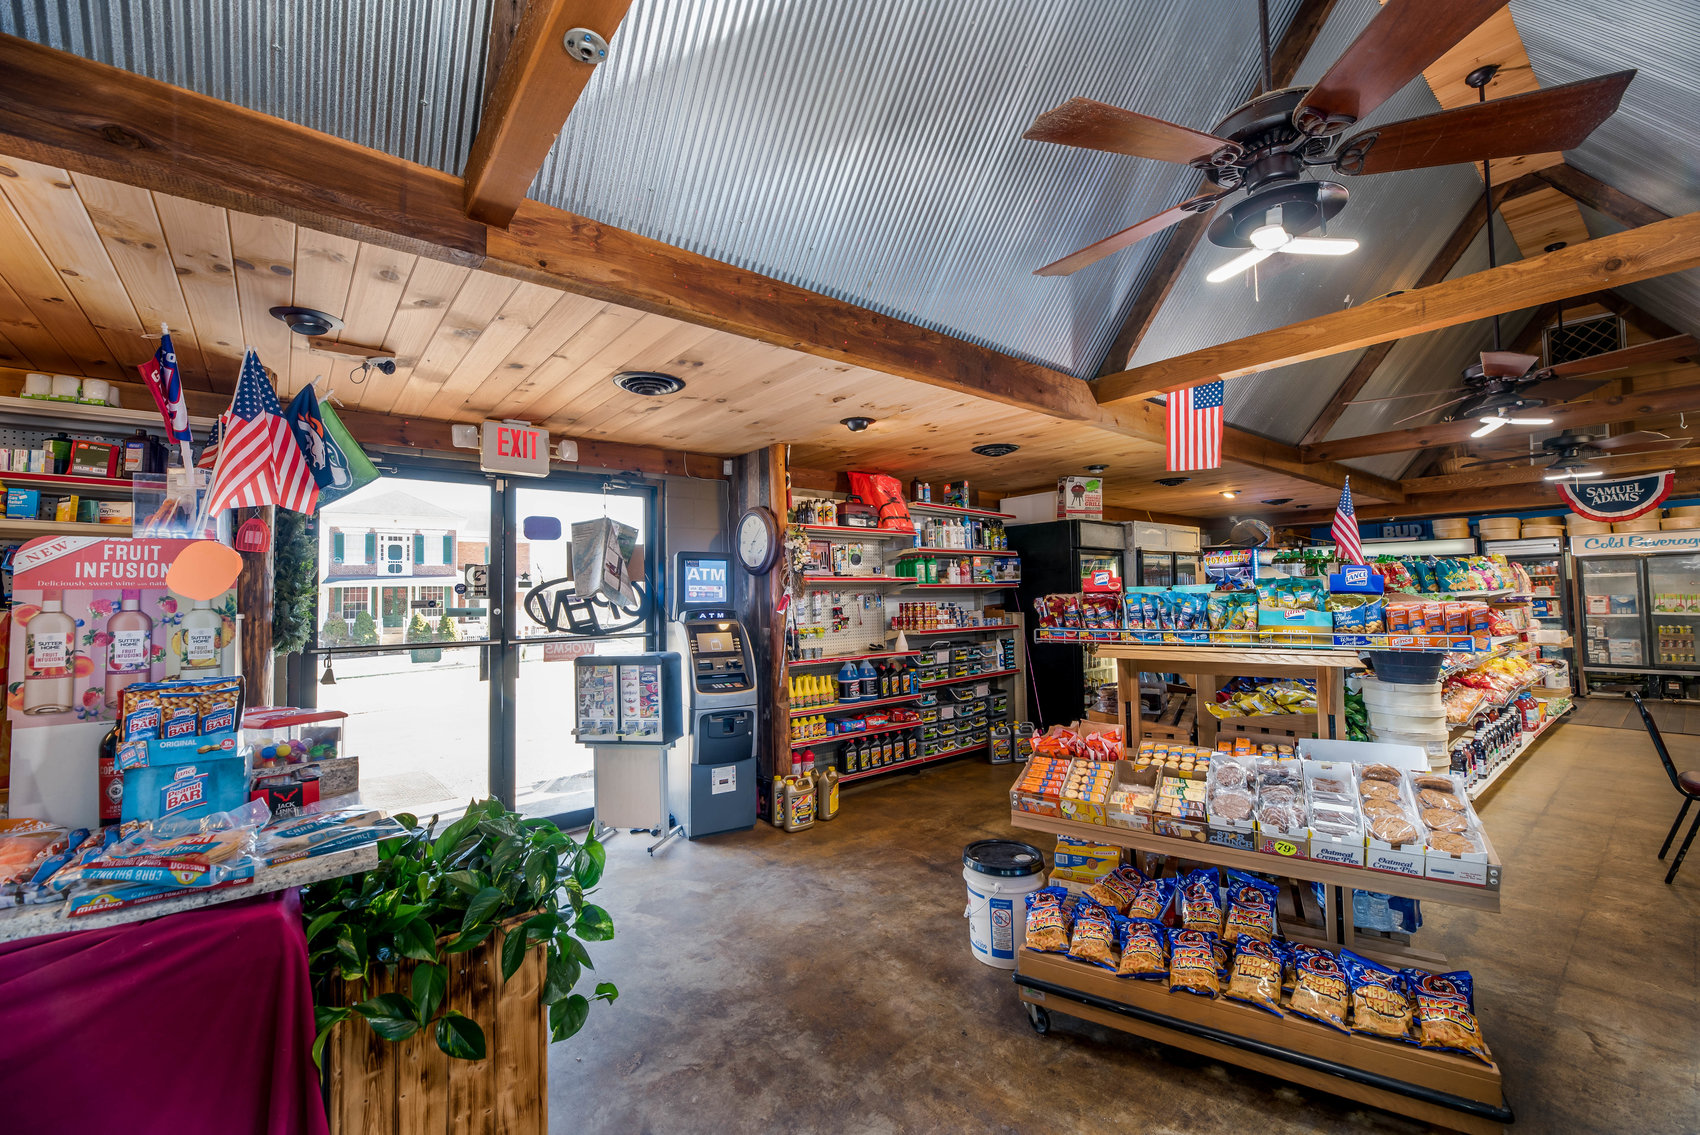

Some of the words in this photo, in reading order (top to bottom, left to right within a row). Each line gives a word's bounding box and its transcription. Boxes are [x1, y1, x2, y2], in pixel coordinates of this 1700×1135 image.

[497, 427, 540, 460] EXIT
[1586, 482, 1645, 498] SAMUEL
[1591, 492, 1641, 506] ADAMS
[1383, 524, 1423, 538] BUD
[1584, 536, 1624, 549] Cold
[1628, 535, 1700, 548] Beverag
[25, 541, 69, 564] NEW
[103, 544, 162, 561] FRUIT
[1205, 556, 1220, 566] TOY
[1223, 553, 1249, 564] CHEST
[687, 567, 725, 581] ATM
[1345, 572, 1368, 582] LANCE
[37, 580, 87, 588] Deliciously
[1284, 608, 1306, 618] Lance
[130, 719, 158, 733] BAR
[168, 724, 195, 737] BAR
[205, 718, 231, 732] BAR
[159, 738, 197, 748] ORIGINAL
[174, 766, 197, 781] Lance
[167, 781, 203, 799] Peanut
[166, 789, 203, 811] BAR
[277, 801, 296, 809] JACK
[1209, 835, 1254, 848] CRUNCH
[1316, 853, 1341, 862] Creme
[1341, 855, 1359, 865] Pies
[1320, 848, 1354, 859] Oatmeal
[1372, 861, 1399, 872] Creme
[1399, 866, 1419, 875] Pies
[1378, 857, 1413, 868] Oatmeal
[135, 869, 163, 881] CARB
[75, 900, 125, 915] mission
[1031, 906, 1061, 920] HOT
[1231, 905, 1271, 920] HOT
[1029, 917, 1065, 932] FRIES
[1229, 913, 1272, 932] FRIES
[1174, 948, 1209, 959] HOT
[1172, 955, 1215, 975] FRIES
[1240, 964, 1276, 983] FRIES
[1417, 995, 1469, 1013] HOT
[1418, 1006, 1476, 1034] FRIES
